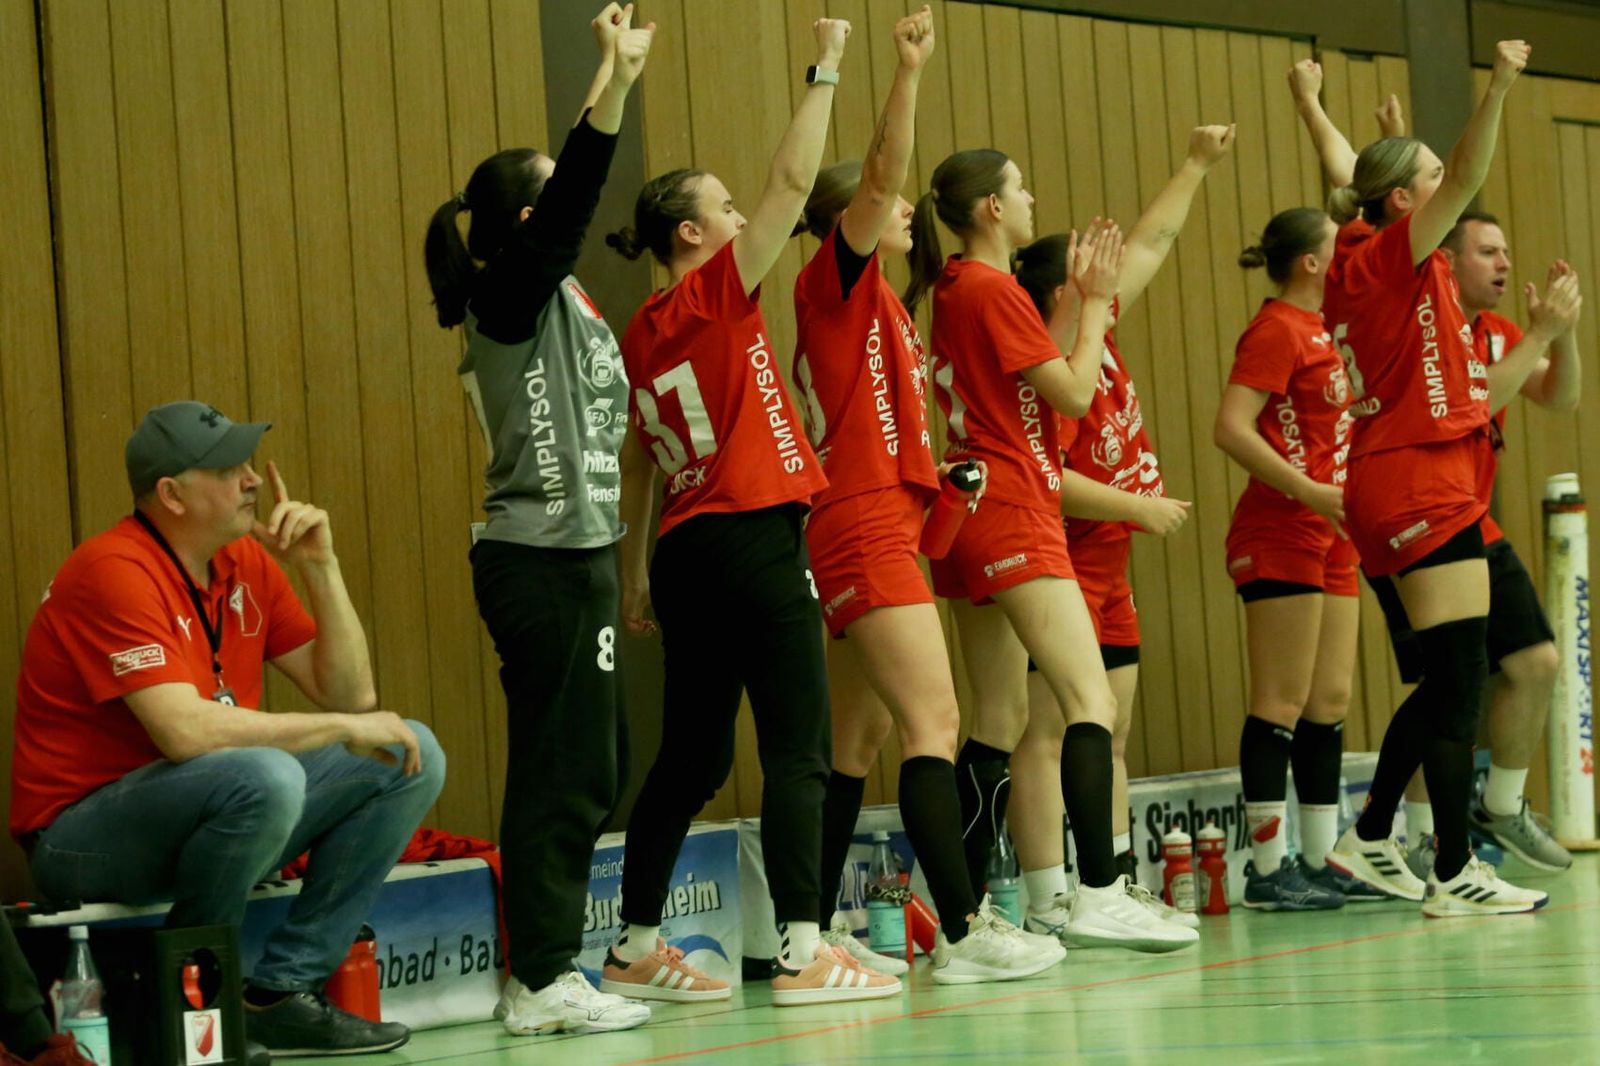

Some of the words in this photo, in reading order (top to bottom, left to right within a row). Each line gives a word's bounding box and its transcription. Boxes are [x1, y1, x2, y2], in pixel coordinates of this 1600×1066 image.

[746, 333, 803, 474] SIMPLYSOL
[866, 318, 898, 456] SIMPLYSOL
[1417, 294, 1448, 417] SIMPLYSOL
[525, 358, 564, 516] SIMPLYSOL
